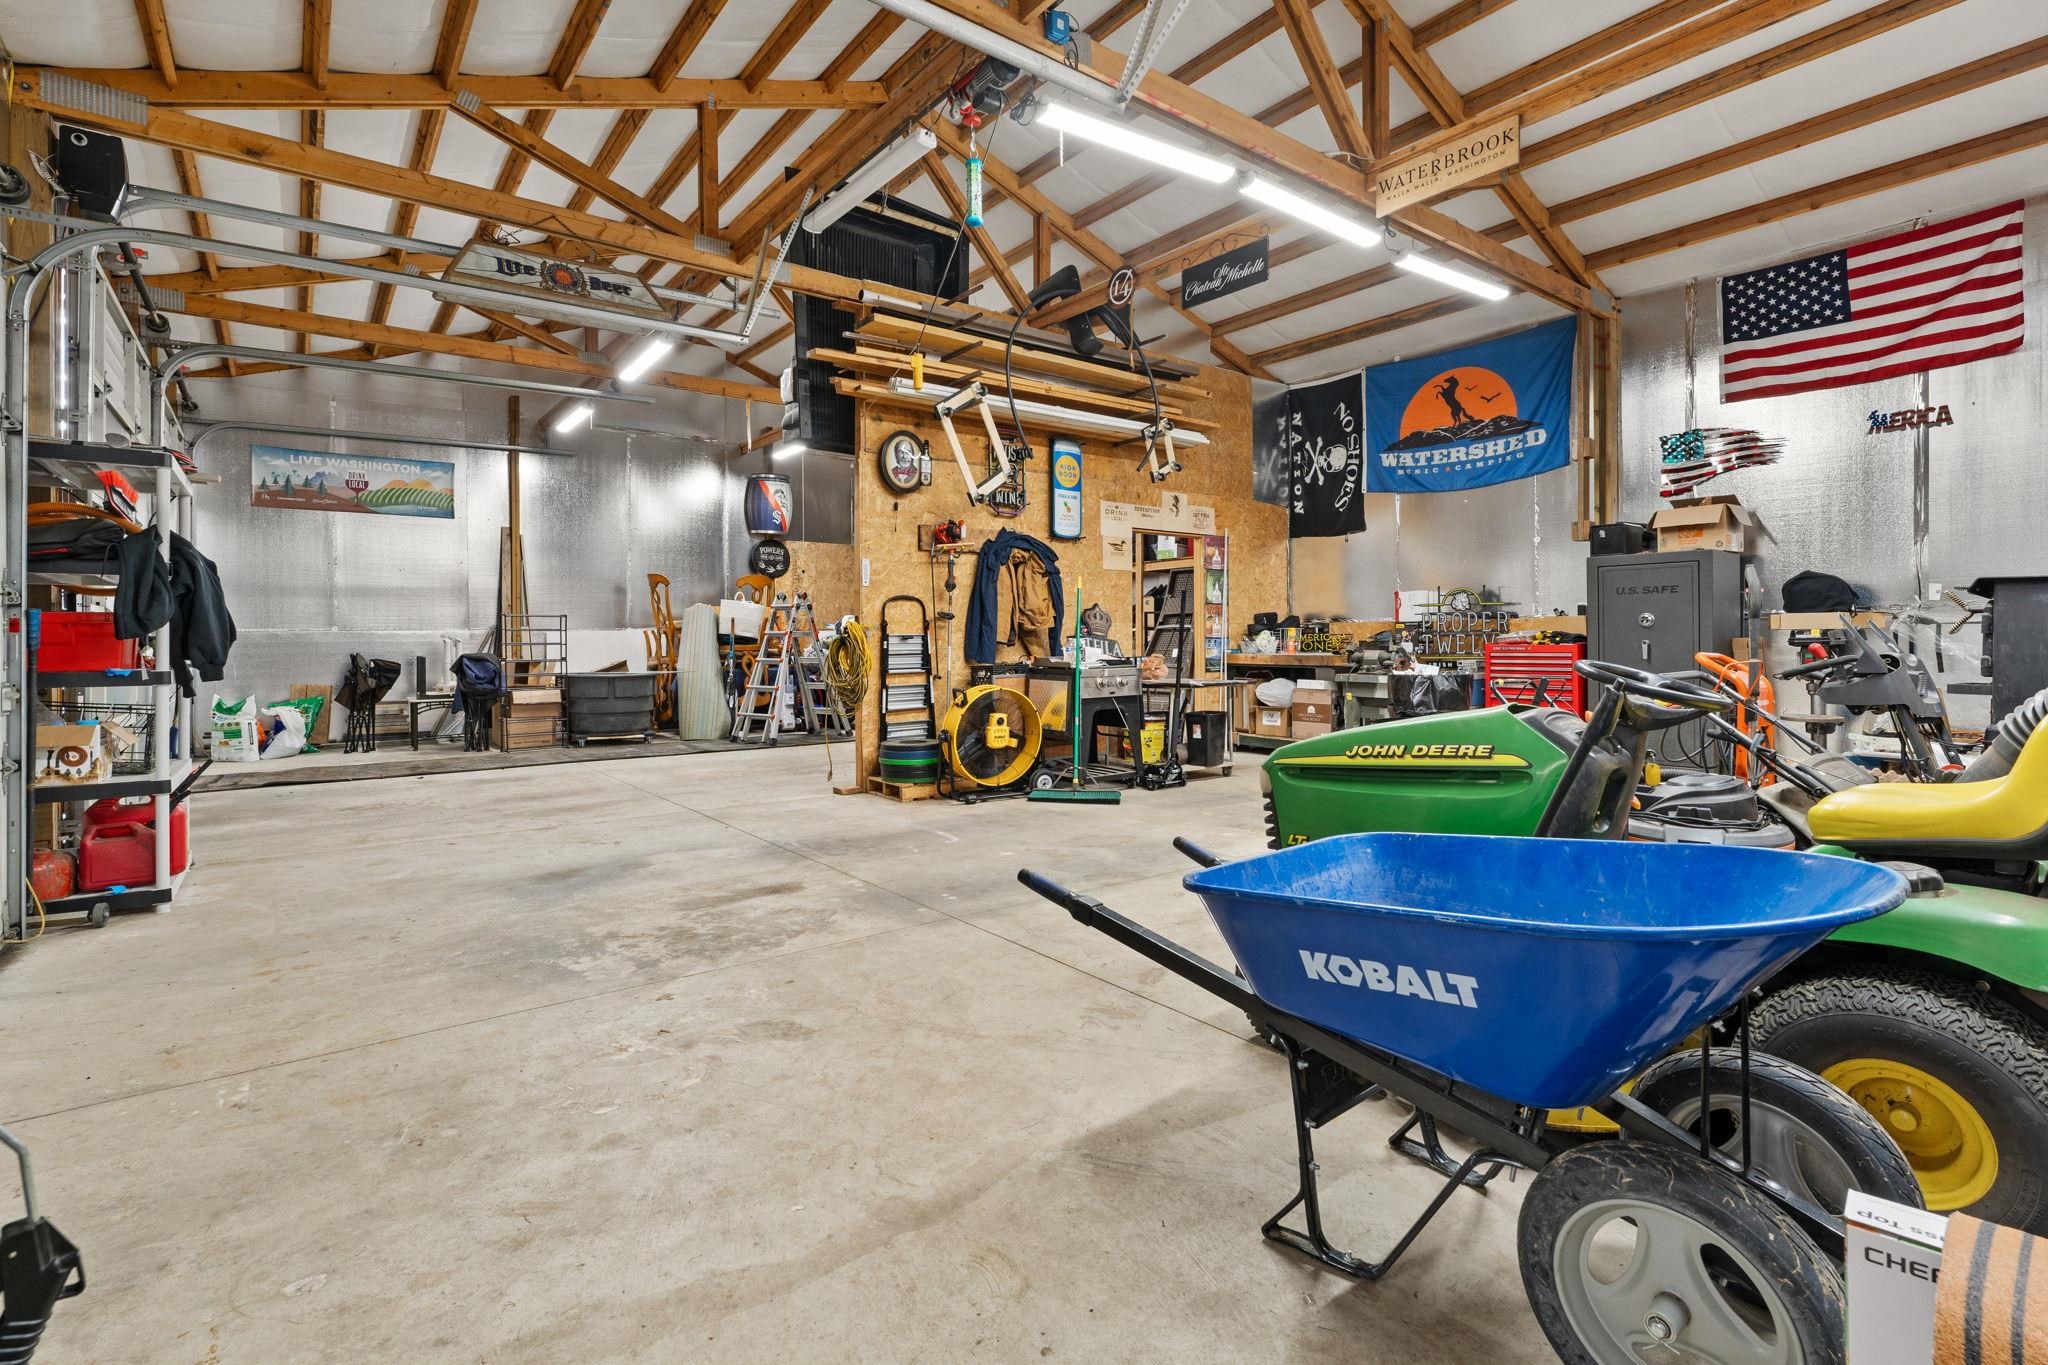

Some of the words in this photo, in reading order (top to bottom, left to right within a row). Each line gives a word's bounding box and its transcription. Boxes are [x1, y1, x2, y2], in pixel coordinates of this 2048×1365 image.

[1378, 127, 1515, 194] WATERBROOK
[1386, 188, 1410, 201] WALLA
[1447, 149, 1506, 177] WASHINGTON
[1213, 262, 1231, 279] Ste
[1217, 257, 1266, 292] Michelle
[587, 275, 633, 296] Beer
[1185, 281, 1223, 302] Chateau
[1333, 401, 1354, 433] NO
[1379, 428, 1547, 468] WATERSHED
[289, 454, 323, 466] LIVE
[326, 457, 421, 475] WASHINGTON
[1060, 464, 1076, 472] HIGH
[1291, 411, 1304, 515] NATION
[1334, 433, 1360, 512] SHOES
[1397, 467, 1439, 476] MUSIC
[1455, 452, 1524, 471] CAMPING
[348, 471, 366, 480] DRINK
[348, 480, 366, 490] LOCAL
[1058, 471, 1077, 479] NOON
[1105, 508, 1129, 517] DRINK
[760, 546, 785, 556] POWERS
[1616, 586, 1639, 595] U.S.
[1642, 584, 1680, 595] SAFE
[1422, 611, 1509, 633] PROPER
[1422, 633, 1496, 655] TWELV
[1345, 744, 1405, 759] JOHN
[1411, 744, 1496, 759] DEERE
[1298, 949, 1479, 1009] KOBALT
[1857, 1209, 1904, 1232] Top
